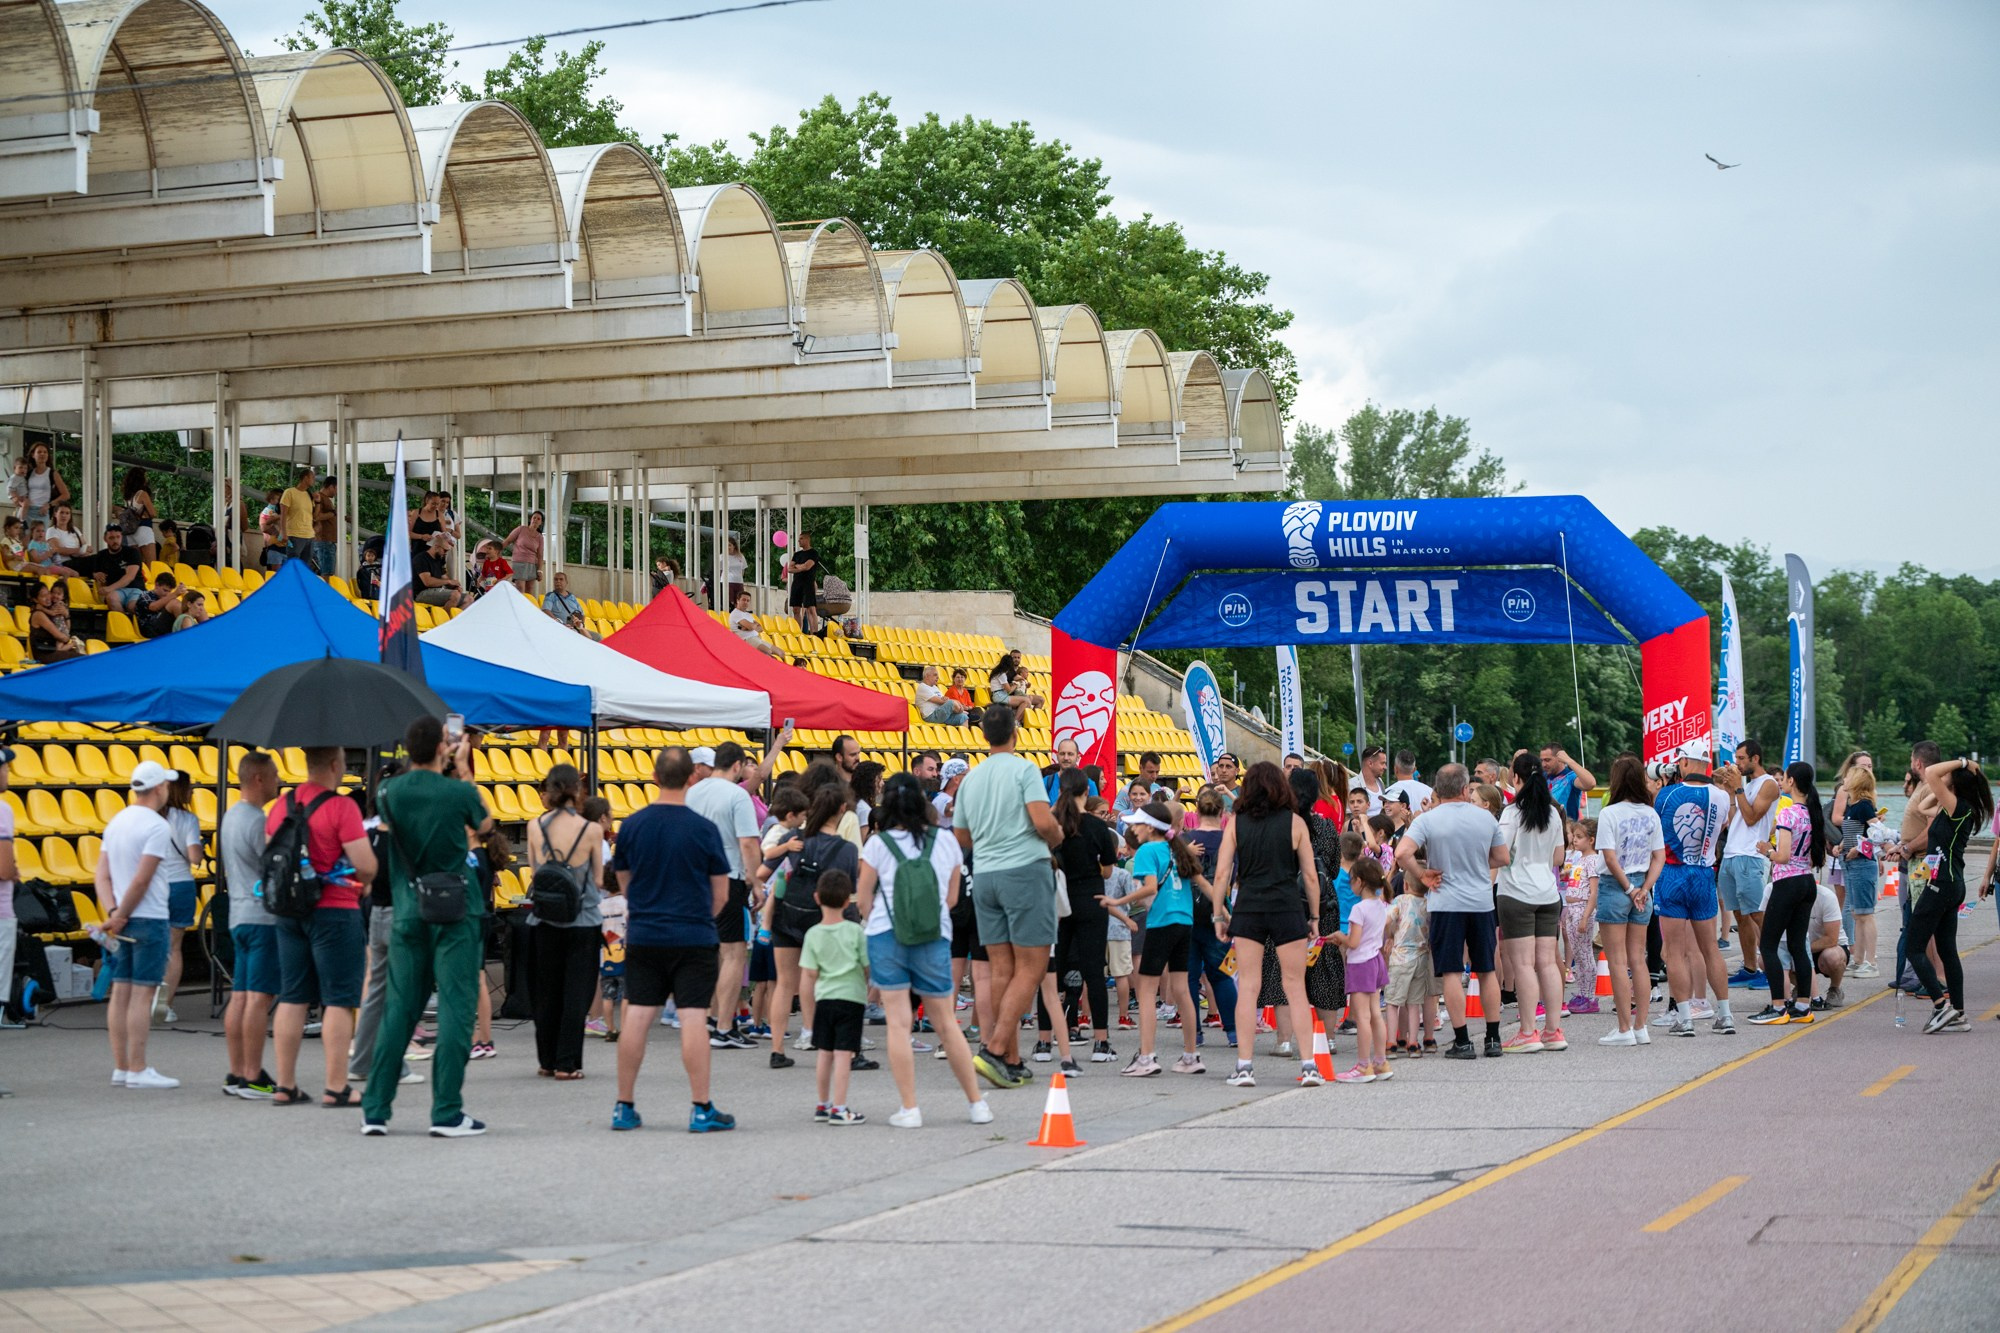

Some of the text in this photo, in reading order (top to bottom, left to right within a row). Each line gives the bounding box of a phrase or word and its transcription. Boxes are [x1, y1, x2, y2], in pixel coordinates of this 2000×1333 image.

[1328, 510, 1417, 532] PLOVDIV
[1328, 537, 1387, 557] HILLS
[1393, 547, 1450, 555] MARKOVO
[1224, 603, 1247, 615] P/H
[1295, 579, 1459, 634] START
[1507, 598, 1530, 610] P/H
[1643, 696, 1689, 738] VERY
[1656, 711, 1706, 752] STEP
[1706, 803, 1718, 838] MATTERS
